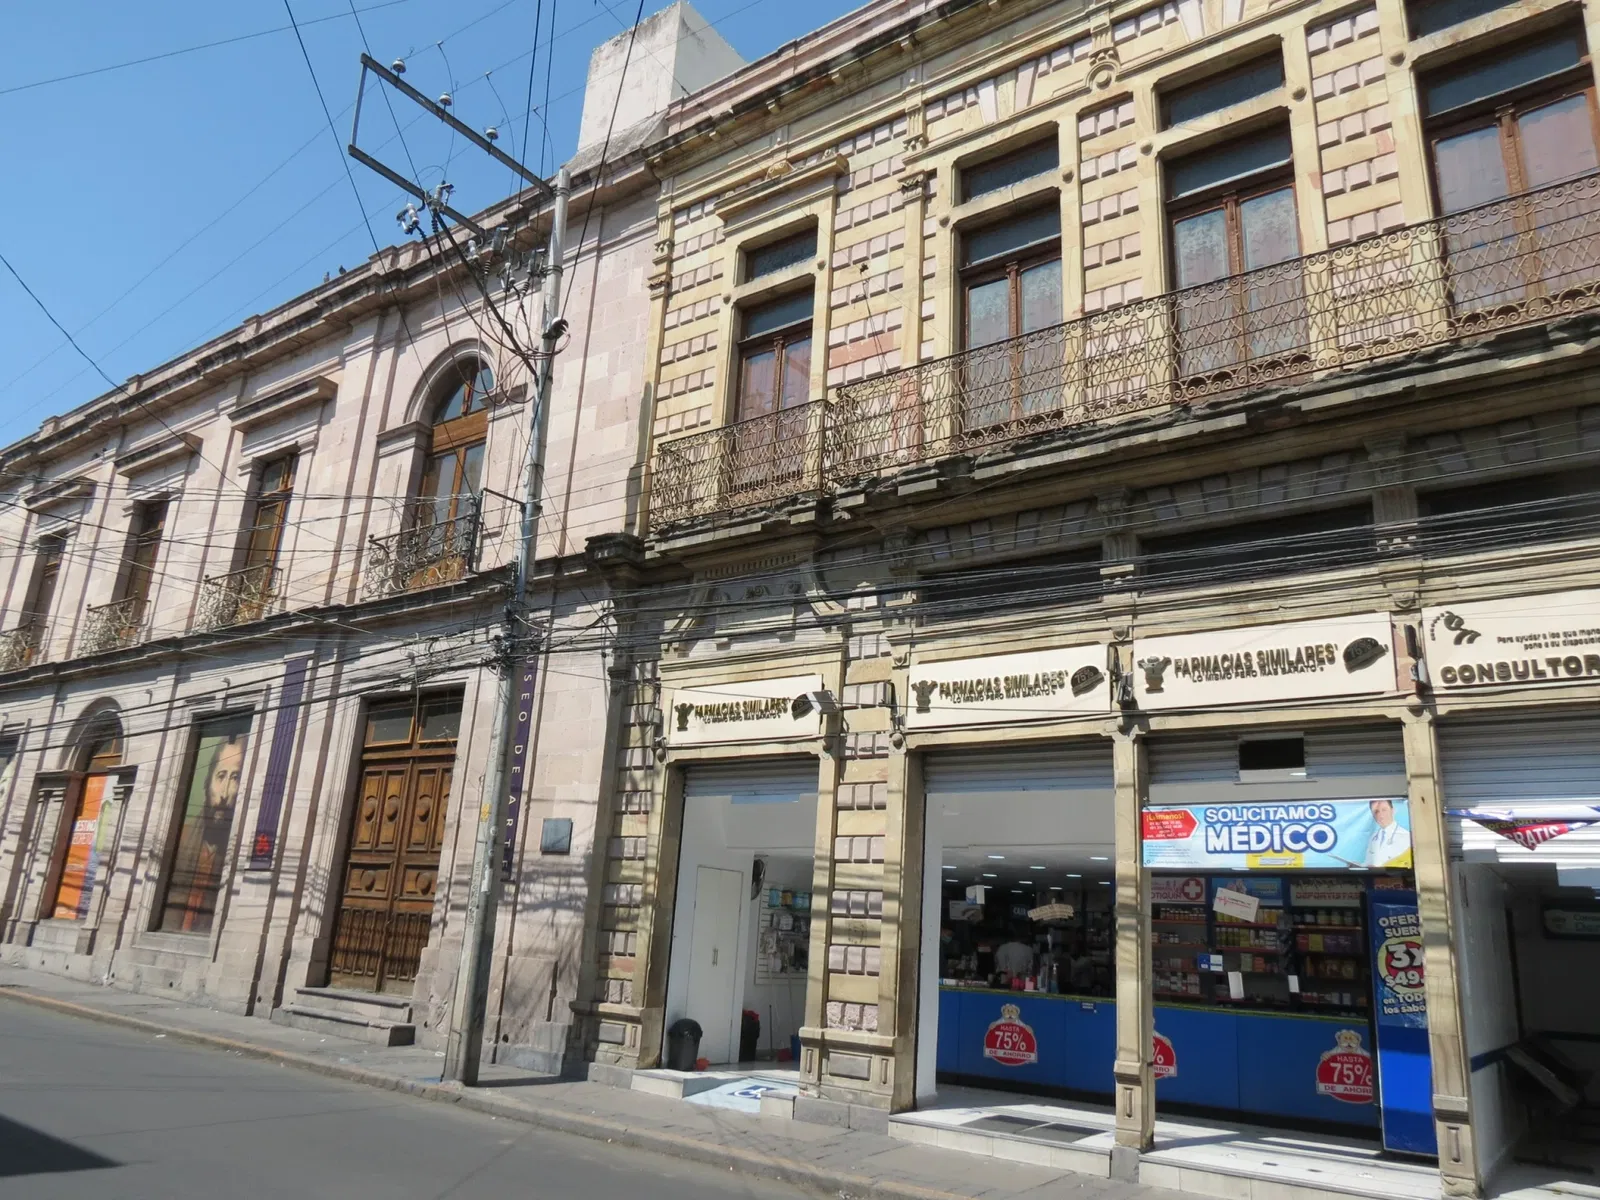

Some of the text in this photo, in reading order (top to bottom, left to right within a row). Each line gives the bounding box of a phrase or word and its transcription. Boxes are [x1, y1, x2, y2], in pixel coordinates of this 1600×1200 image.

[1174, 643, 1337, 677] FARMACIAS SIMILARES
[1440, 654, 1600, 684] CONSULTOR
[518, 645, 536, 722] USEO
[1192, 674, 1203, 683] LO
[1205, 672, 1232, 682] MISMO
[1234, 670, 1258, 680] PERO
[1281, 665, 1318, 676] BARATO
[939, 670, 1066, 699] FARMACIAS SIMILARES
[694, 698, 789, 718] FARMACIAS SIMILARES
[511, 745, 523, 774] DE
[1204, 804, 1335, 823] SOLICITAMOS
[1206, 823, 1336, 853] MÉDICO
[1379, 914, 1421, 927] OFER
[1383, 996, 1396, 1005] en
[1384, 1005, 1400, 1014] los
[1000, 1024, 1020, 1032] HASTA
[994, 1031, 1027, 1051] 75%
[1002, 1051, 1032, 1059] AHORRO
[1337, 1055, 1363, 1063] HASTA
[1329, 1062, 1372, 1086] 75%
